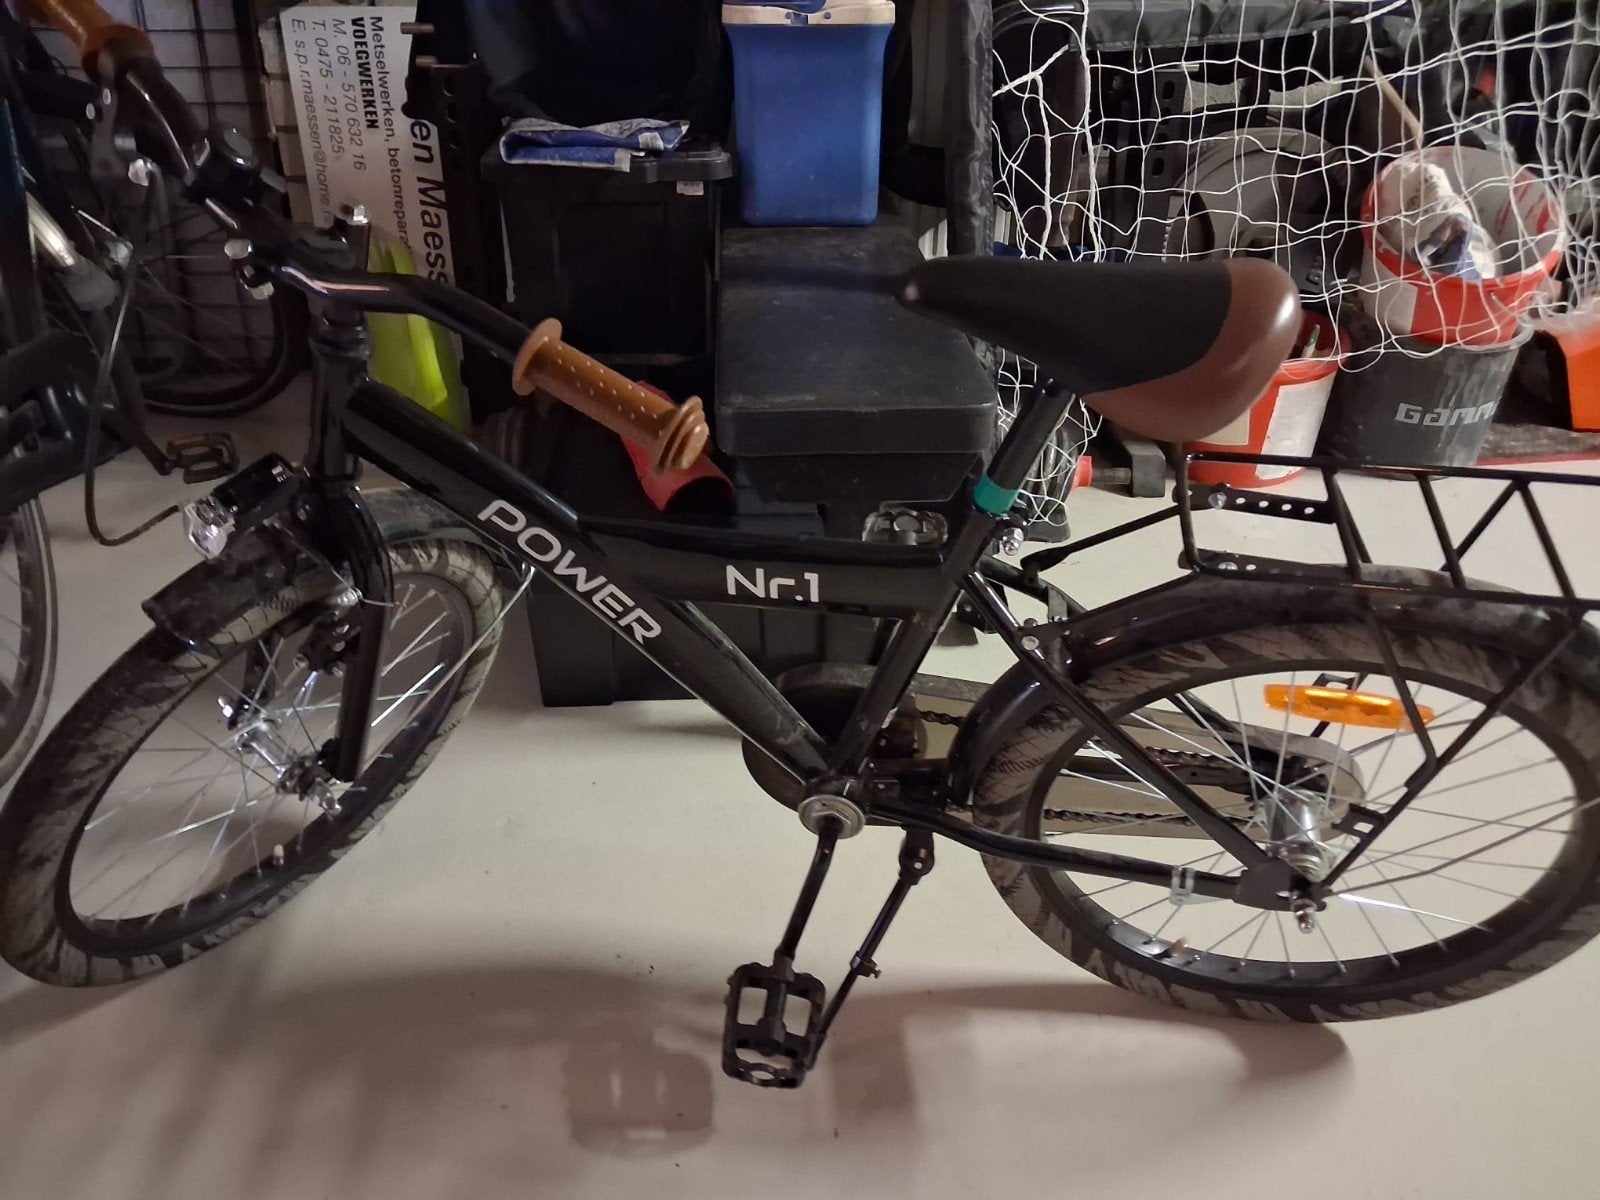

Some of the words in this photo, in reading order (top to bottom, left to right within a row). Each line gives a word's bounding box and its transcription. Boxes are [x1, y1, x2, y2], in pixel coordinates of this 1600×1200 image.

[292, 19, 306, 33] E.
[312, 20, 326, 31] T.
[332, 18, 347, 38] M.
[315, 37, 334, 78] 0475
[336, 45, 351, 66] 06
[351, 17, 379, 129] VOEGWERKEN
[370, 16, 396, 143] Metselwerken,
[342, 82, 358, 113] 570
[323, 95, 345, 154] 211825
[347, 118, 364, 147] 632
[353, 153, 367, 171] 16
[477, 499, 662, 645] POWER
[725, 564, 820, 602] Nr.1
